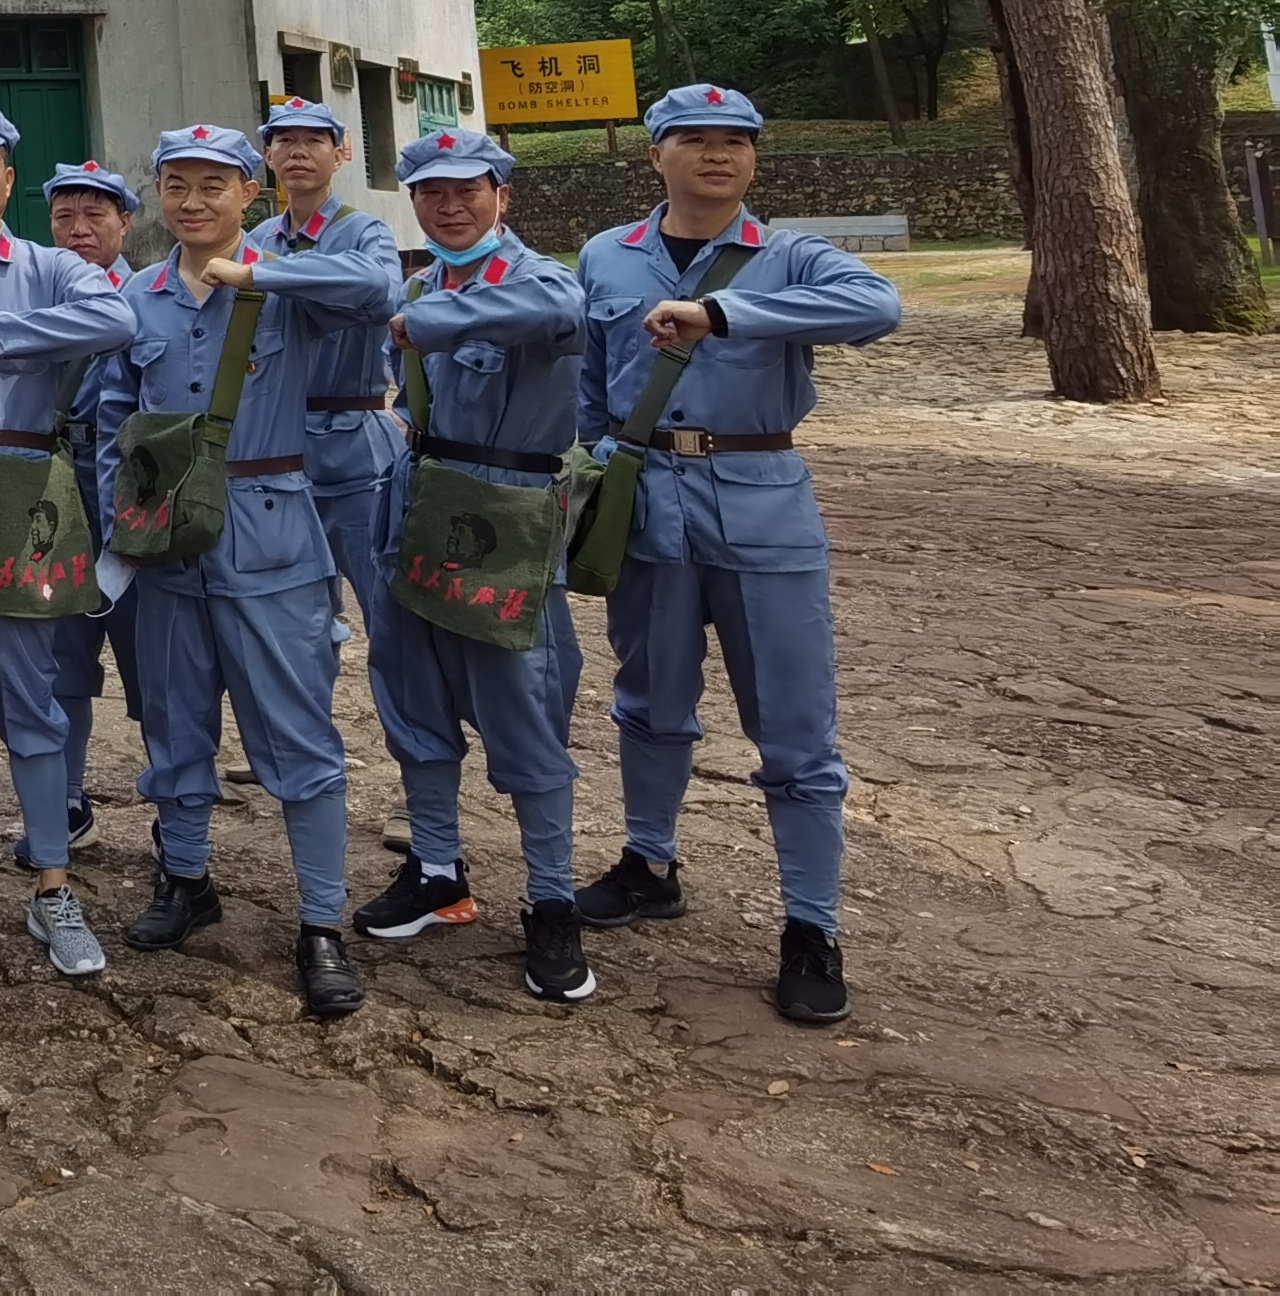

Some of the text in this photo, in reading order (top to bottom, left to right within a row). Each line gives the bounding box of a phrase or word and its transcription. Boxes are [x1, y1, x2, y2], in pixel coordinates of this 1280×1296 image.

[500, 54, 601, 78] 飞机洞
[498, 96, 610, 111] BOMB SHELTER
